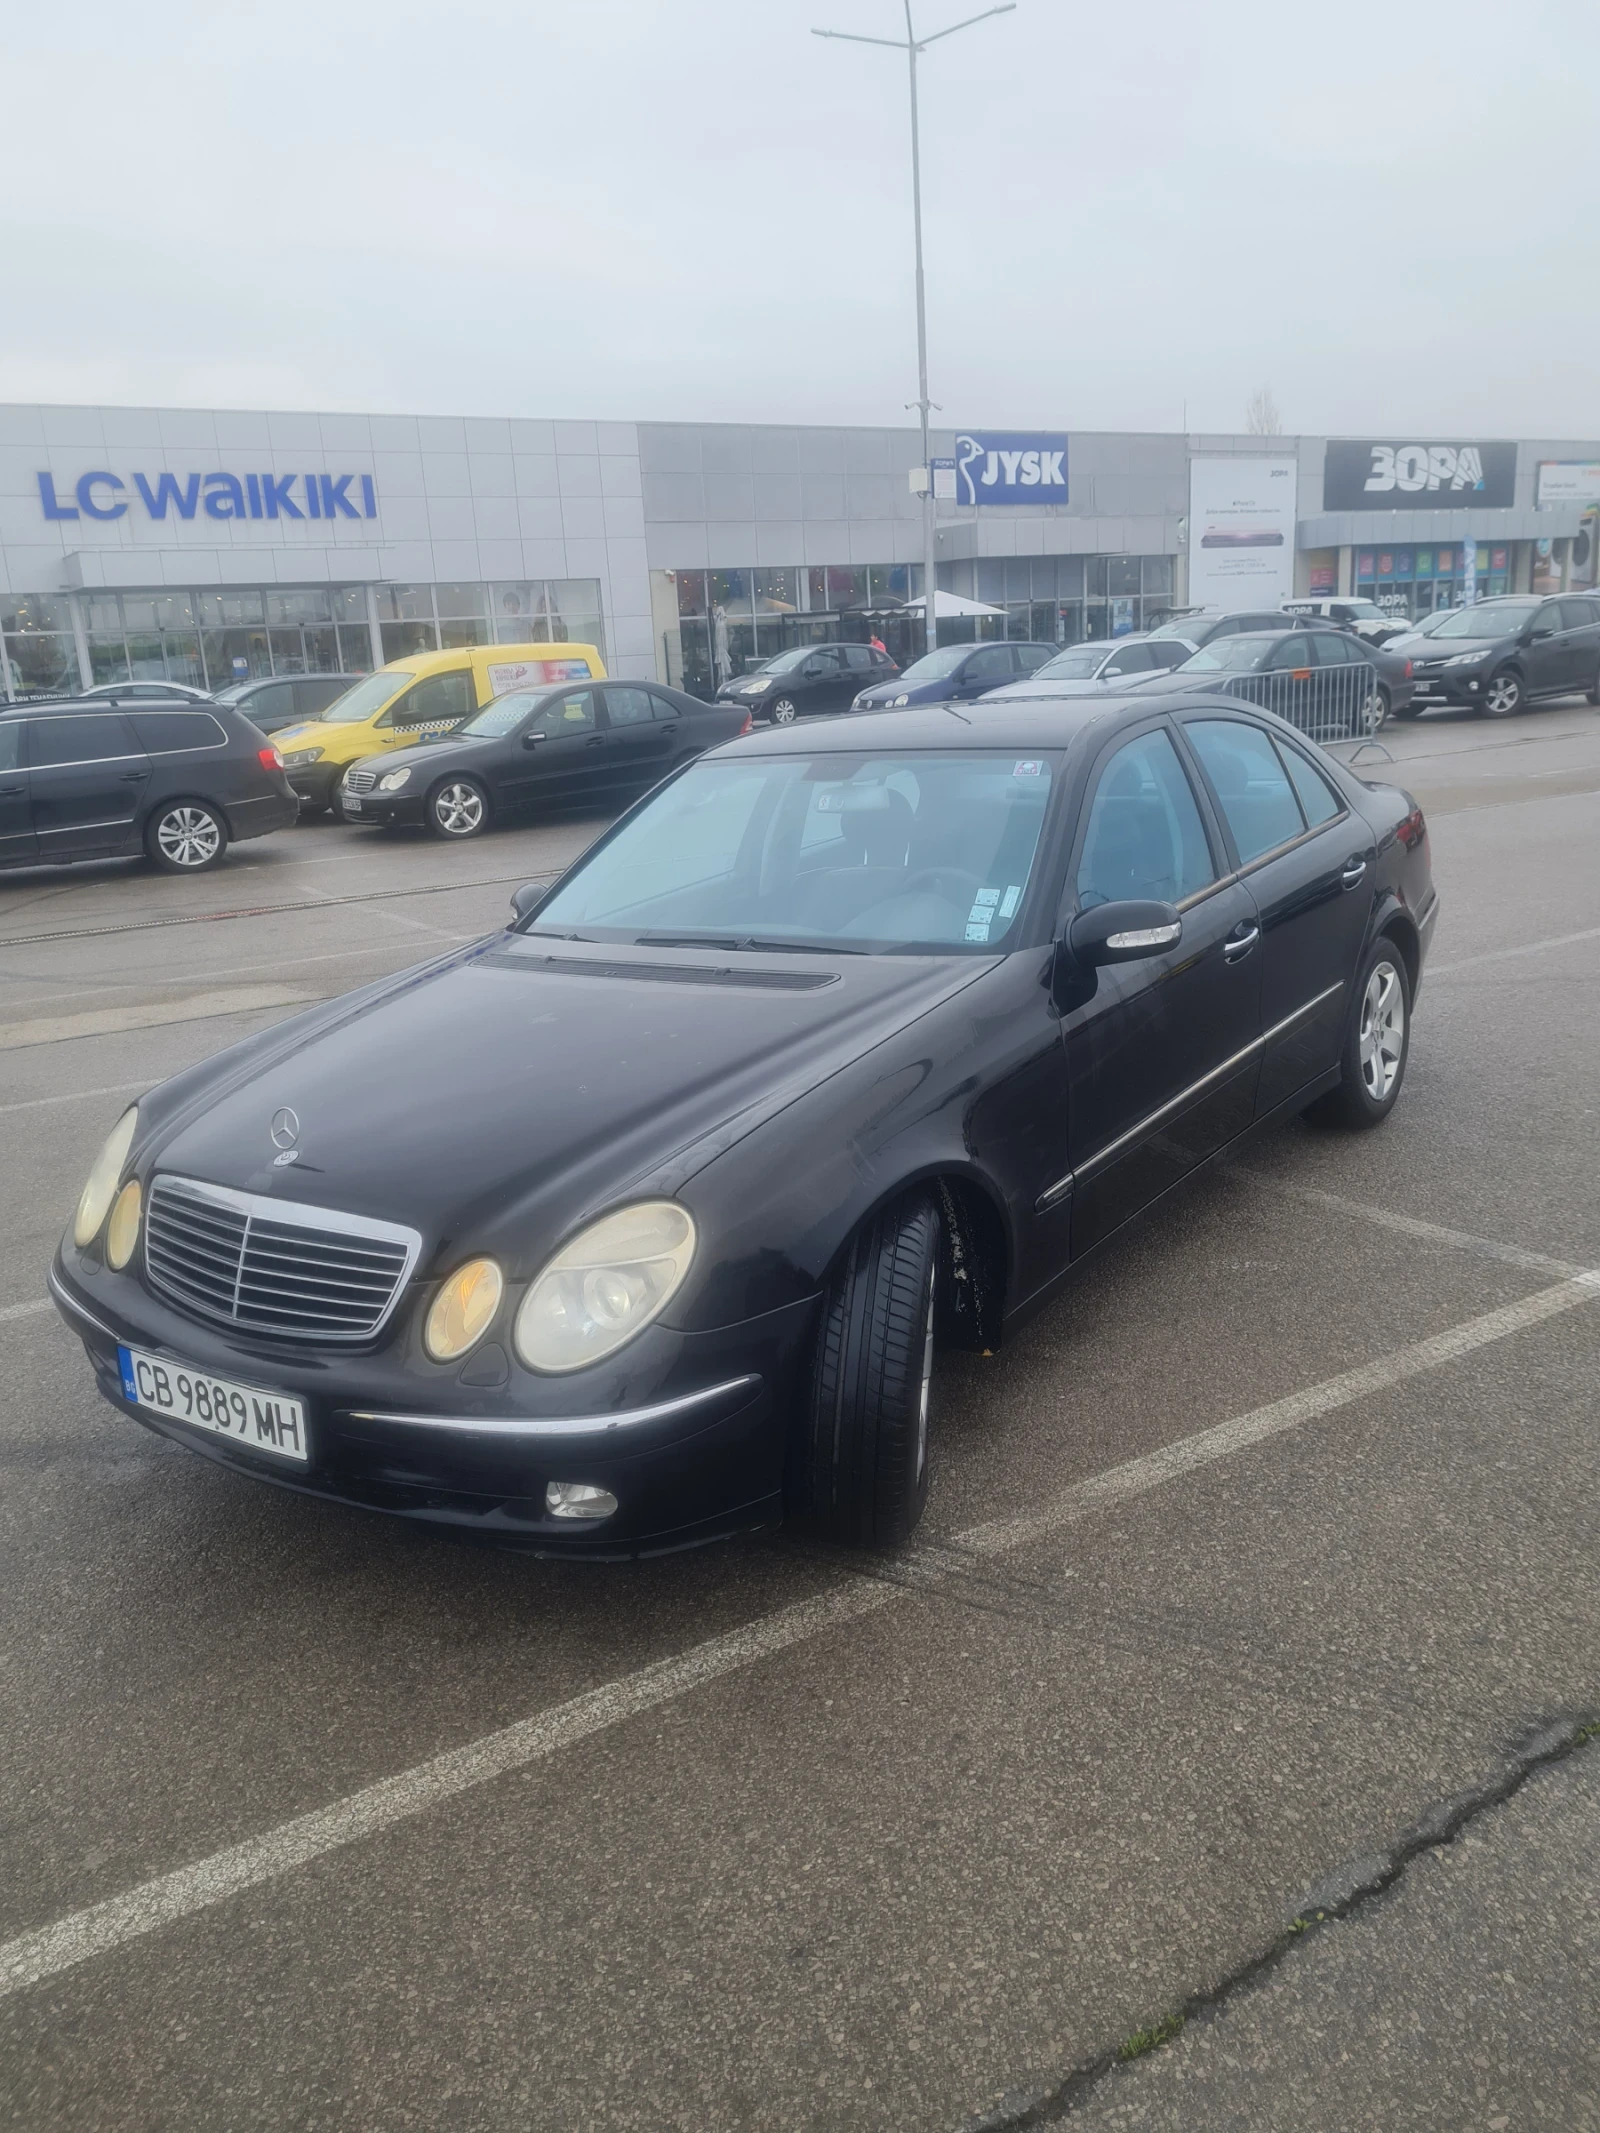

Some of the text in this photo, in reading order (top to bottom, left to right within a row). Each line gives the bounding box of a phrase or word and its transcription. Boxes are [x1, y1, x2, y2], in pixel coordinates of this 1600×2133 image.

[981, 451, 1065, 485] JYSK
[1363, 446, 1485, 491] ЗОРА
[37, 471, 128, 520] LC
[125, 1379, 136, 1394] BG
[177, 1374, 247, 1434] 9889
